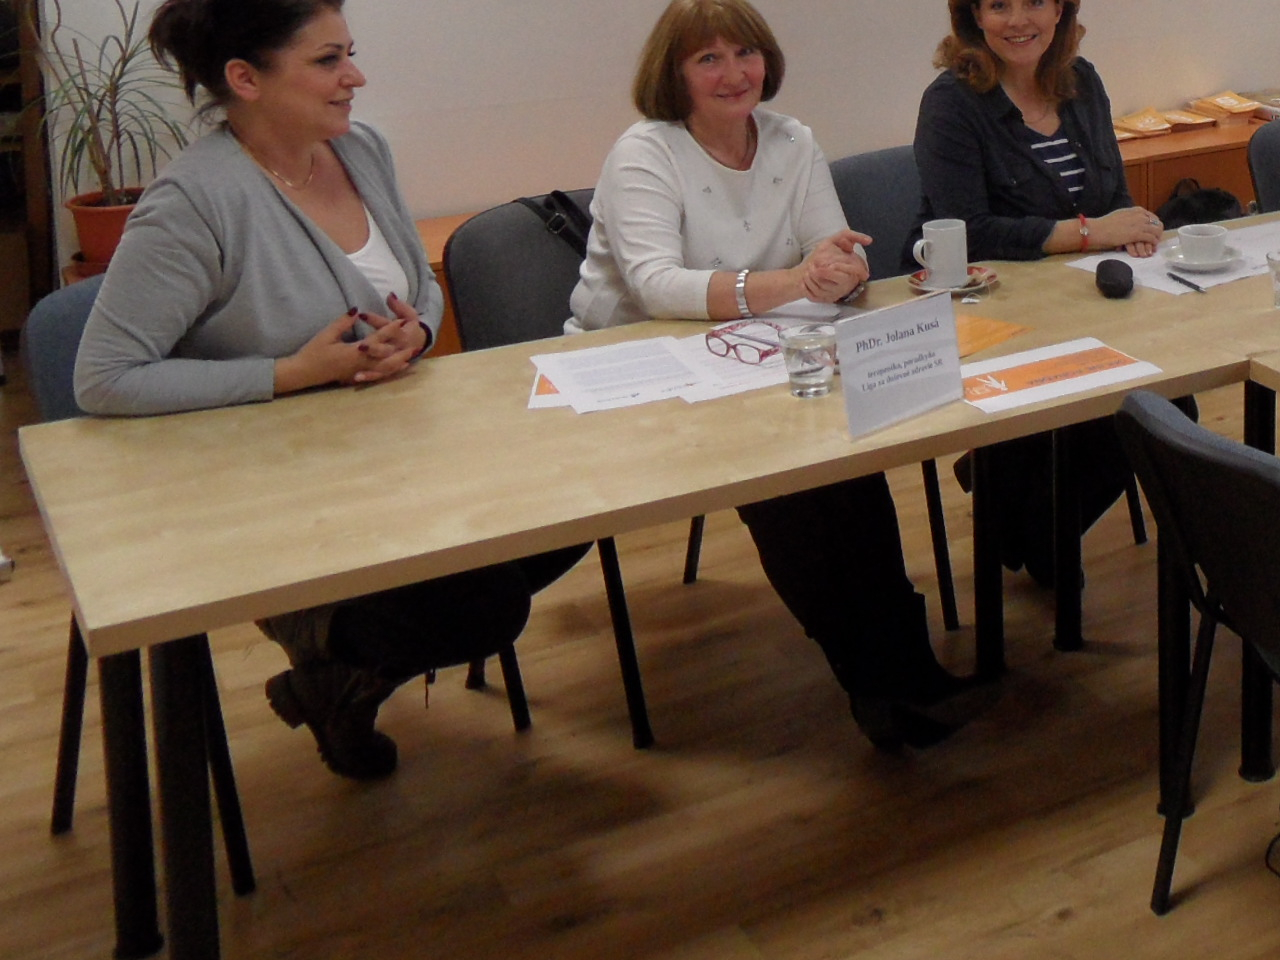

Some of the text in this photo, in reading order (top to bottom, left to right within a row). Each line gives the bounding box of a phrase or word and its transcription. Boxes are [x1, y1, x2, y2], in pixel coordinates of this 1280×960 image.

[855, 317, 940, 353] PhDr. Jolana Kusá
